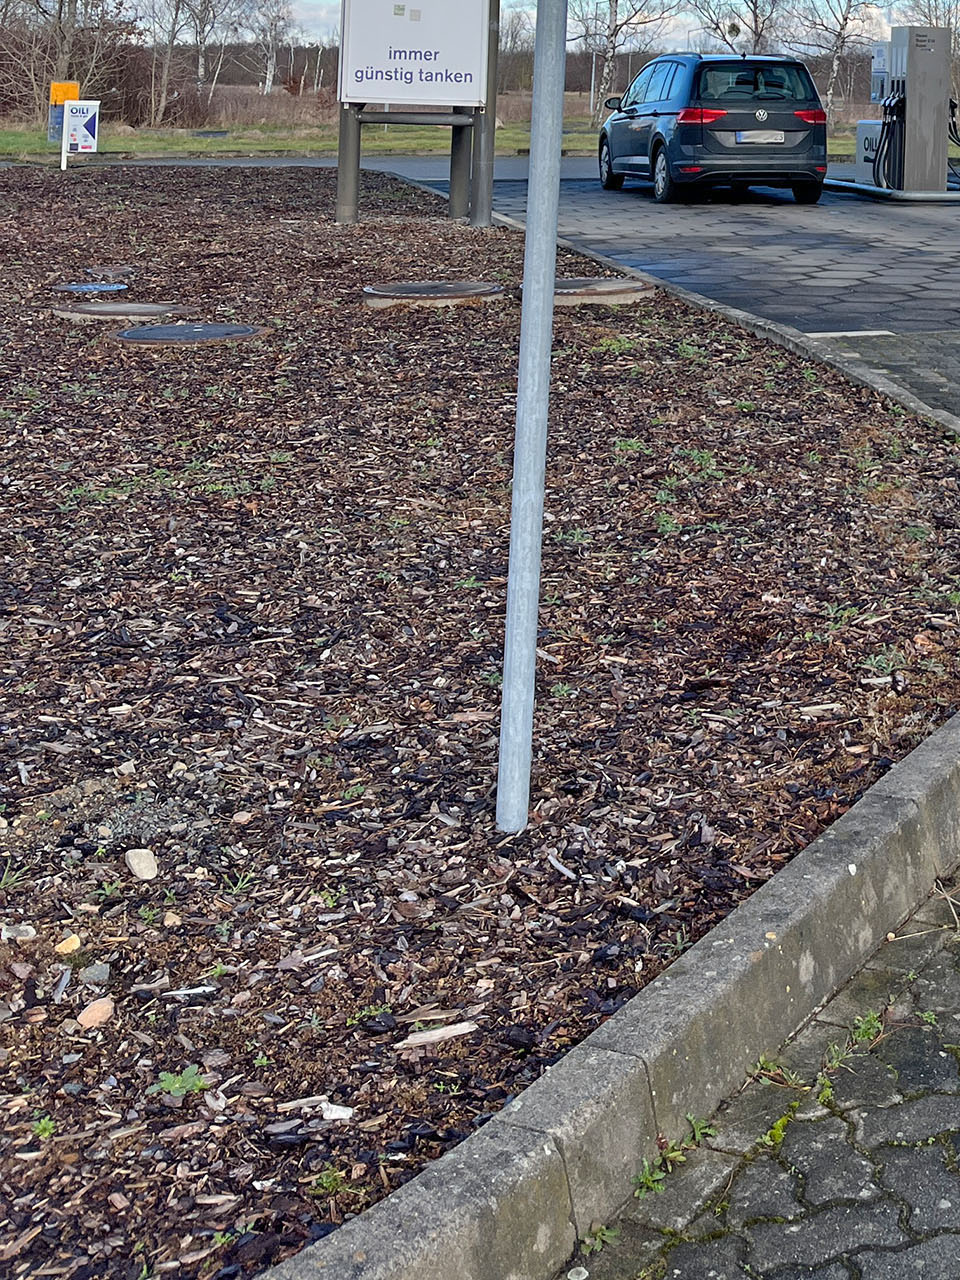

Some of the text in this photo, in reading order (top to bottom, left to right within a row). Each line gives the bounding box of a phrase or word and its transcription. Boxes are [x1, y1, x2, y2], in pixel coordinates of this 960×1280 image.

[388, 46, 440, 61] immer
[354, 66, 473, 84] günstig tanken
